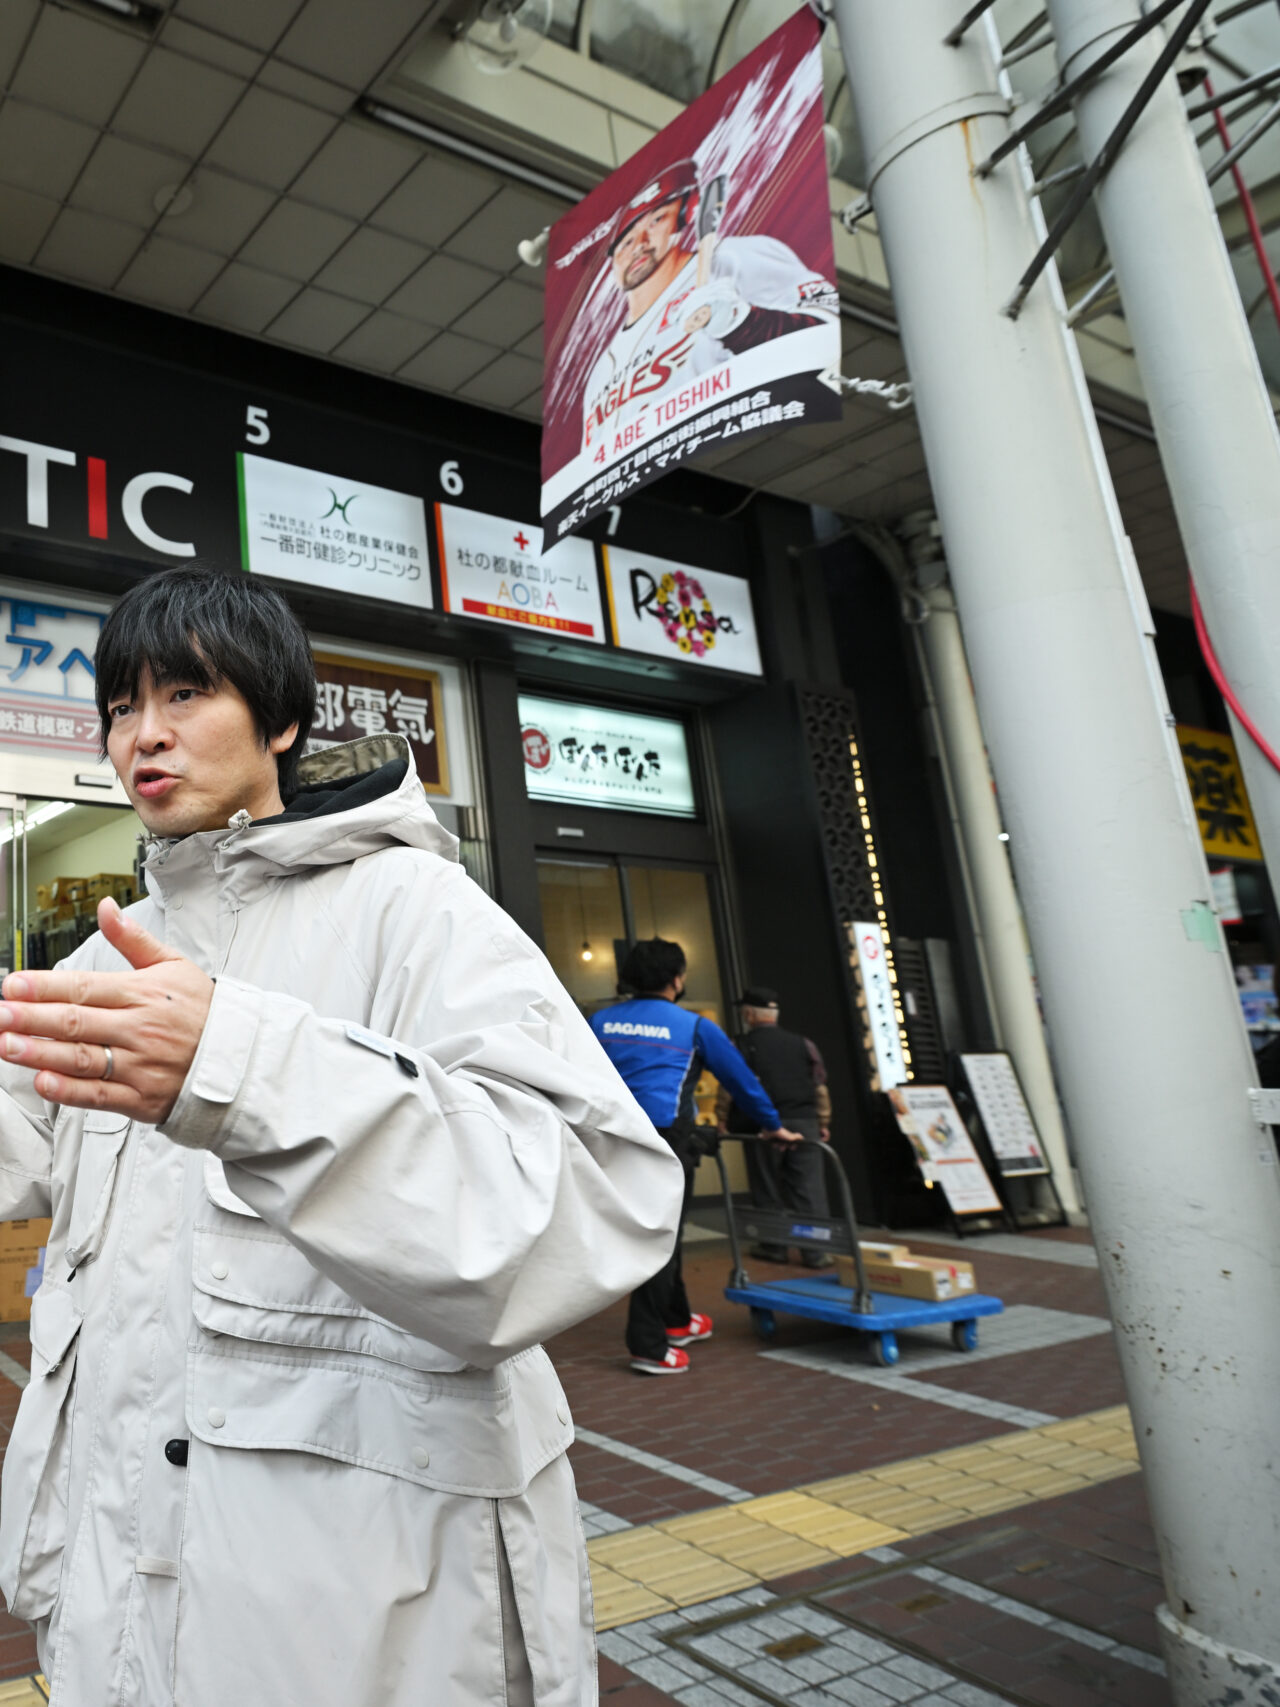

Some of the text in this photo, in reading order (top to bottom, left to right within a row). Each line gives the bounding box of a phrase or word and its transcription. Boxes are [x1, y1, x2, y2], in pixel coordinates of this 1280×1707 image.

[584, 334, 695, 448] EAGLES
[246, 405, 271, 445] 5
[593, 367, 732, 465] 4 ABE TOSHIKI
[572, 390, 773, 506] 一番町四丁目商店街振興組合
[439, 460, 464, 496] 6
[260, 533, 422, 581] 一番町健診クリニック
[319, 526, 420, 560] 杜の都産業保健会
[457, 547, 589, 592] 杜の都献血ルーム
[497, 580, 559, 612] AOBA
[603, 1021, 672, 1040] SAGAWA
